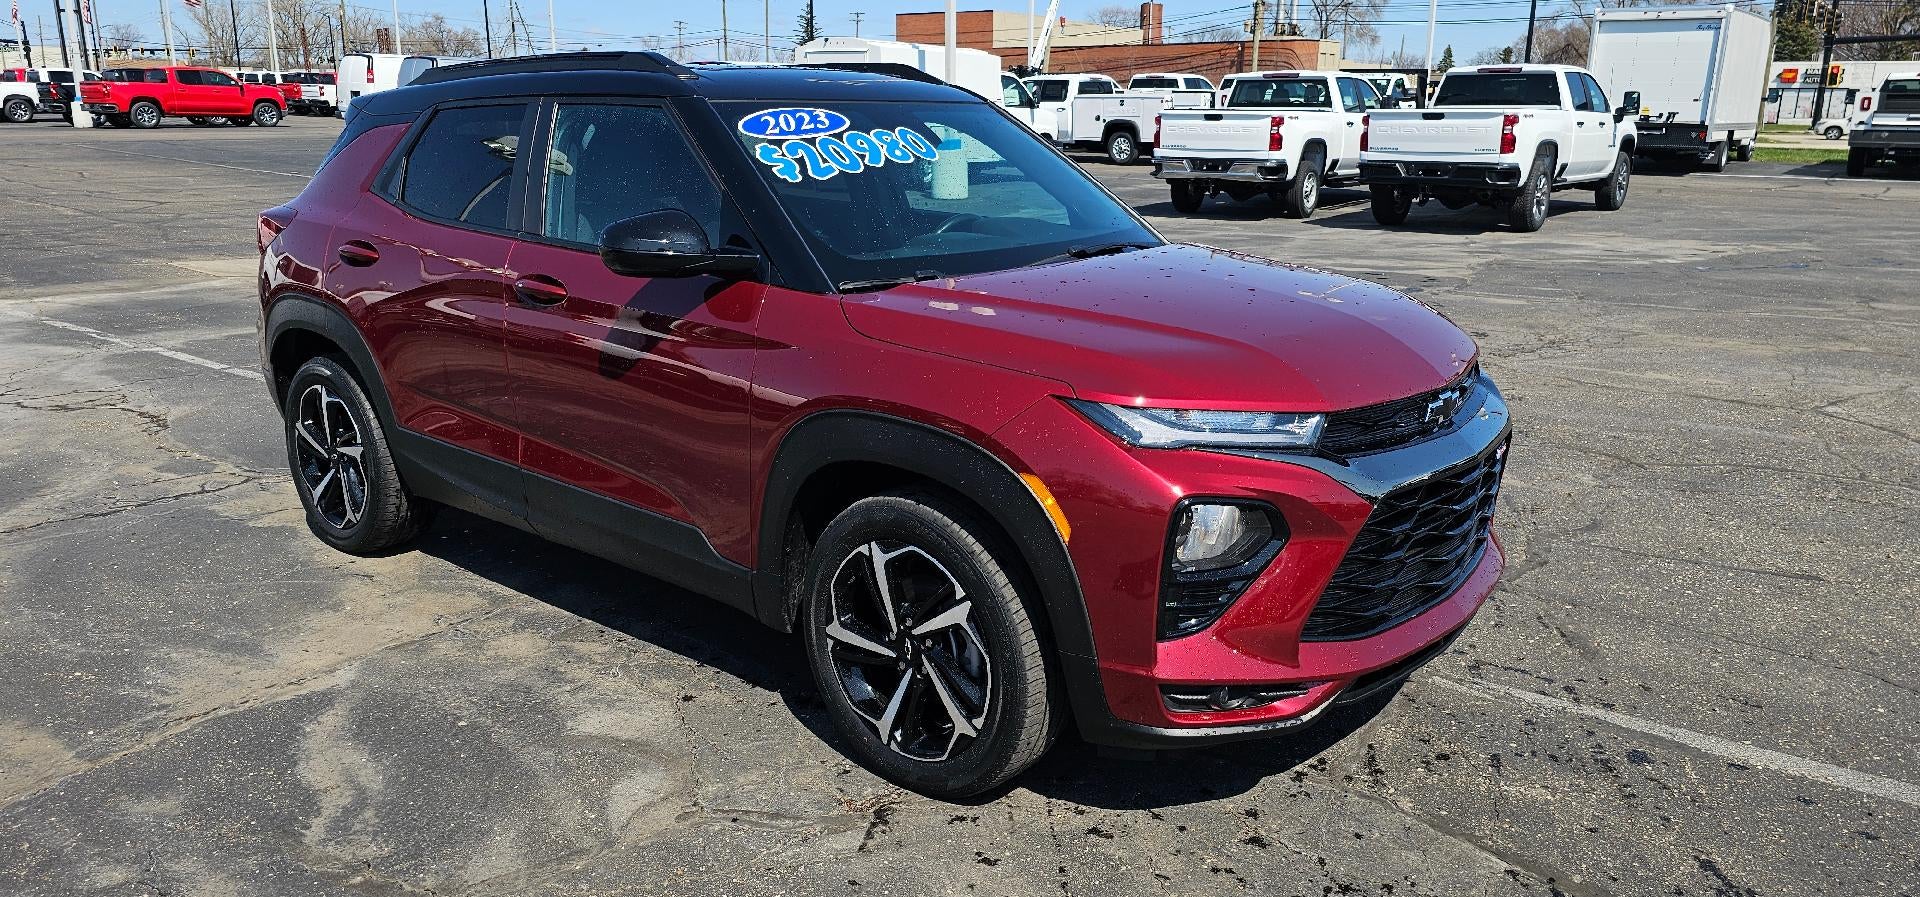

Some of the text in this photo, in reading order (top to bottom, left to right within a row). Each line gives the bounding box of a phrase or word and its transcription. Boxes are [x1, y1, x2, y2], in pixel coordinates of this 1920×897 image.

[760, 111, 830, 134] 2023
[1167, 125, 1262, 134] CHEVROLET
[1376, 125, 1493, 135] CHEVROLET
[755, 127, 940, 183] $20980
